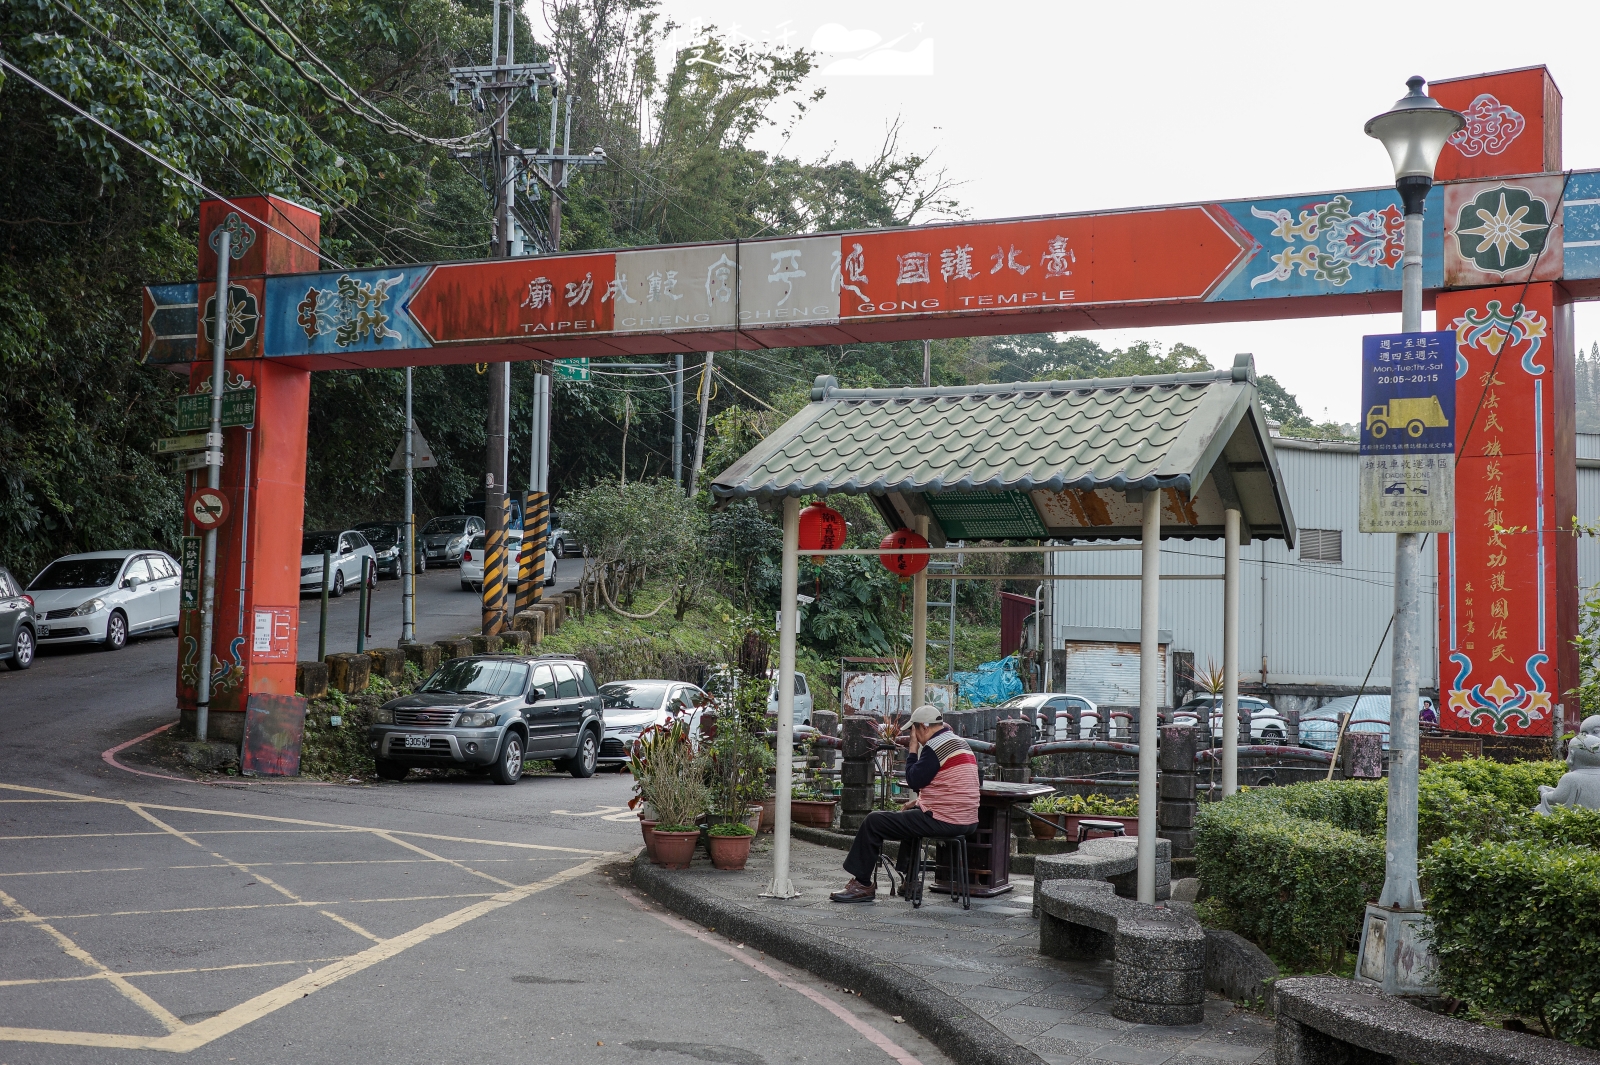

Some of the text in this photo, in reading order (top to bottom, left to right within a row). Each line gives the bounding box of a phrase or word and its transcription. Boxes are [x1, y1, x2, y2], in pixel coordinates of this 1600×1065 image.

[520, 289, 1076, 333] TAIPEI CHENG CHENG GONG TEMPLE
[1380, 338, 1440, 349] 週一至週二
[1379, 350, 1438, 362] 週四至週六
[1378, 374, 1438, 384] 20:05~20:15
[1365, 459, 1447, 470] 垃圾車收運專區
